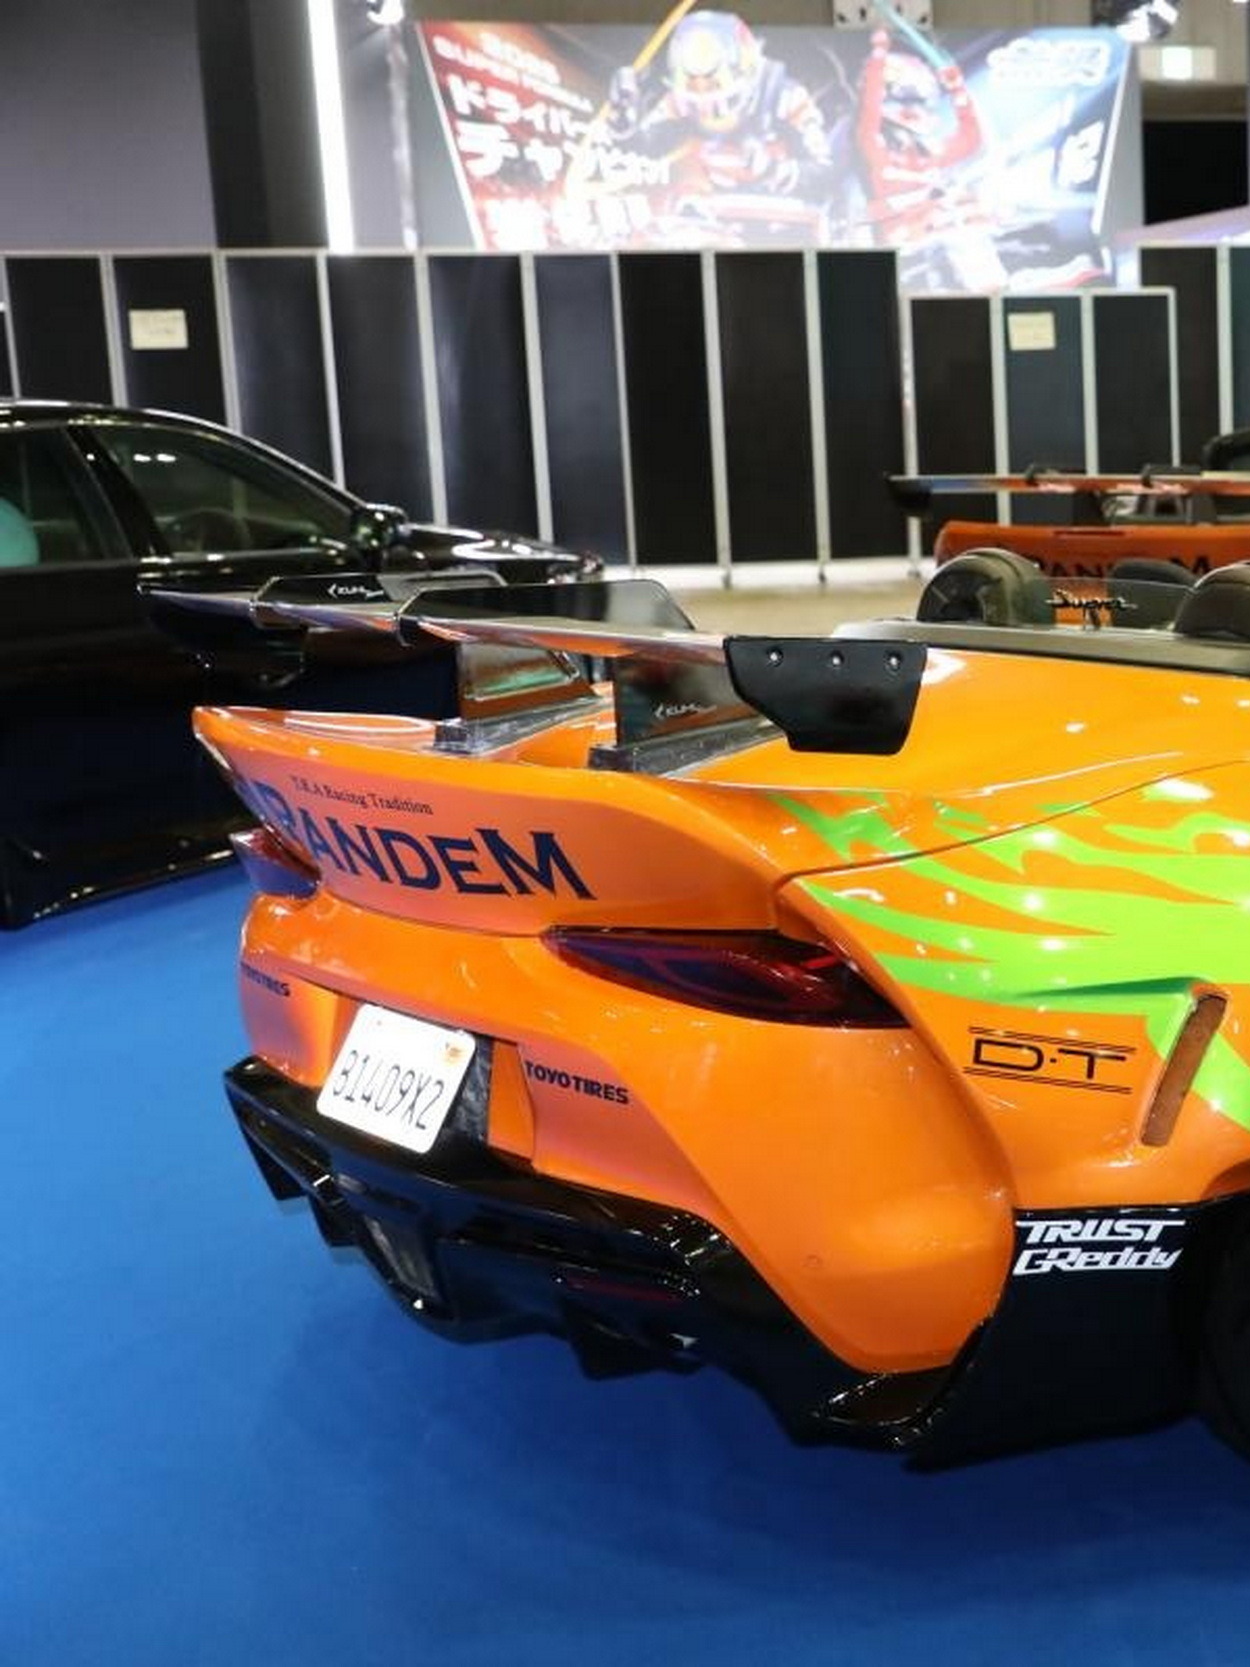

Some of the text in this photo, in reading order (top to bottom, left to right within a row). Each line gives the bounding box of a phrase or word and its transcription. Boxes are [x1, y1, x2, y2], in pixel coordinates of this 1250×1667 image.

[324, 784, 369, 809] Racing
[366, 793, 434, 815] Tradition
[1015, 1219, 1186, 1244] TRUST
